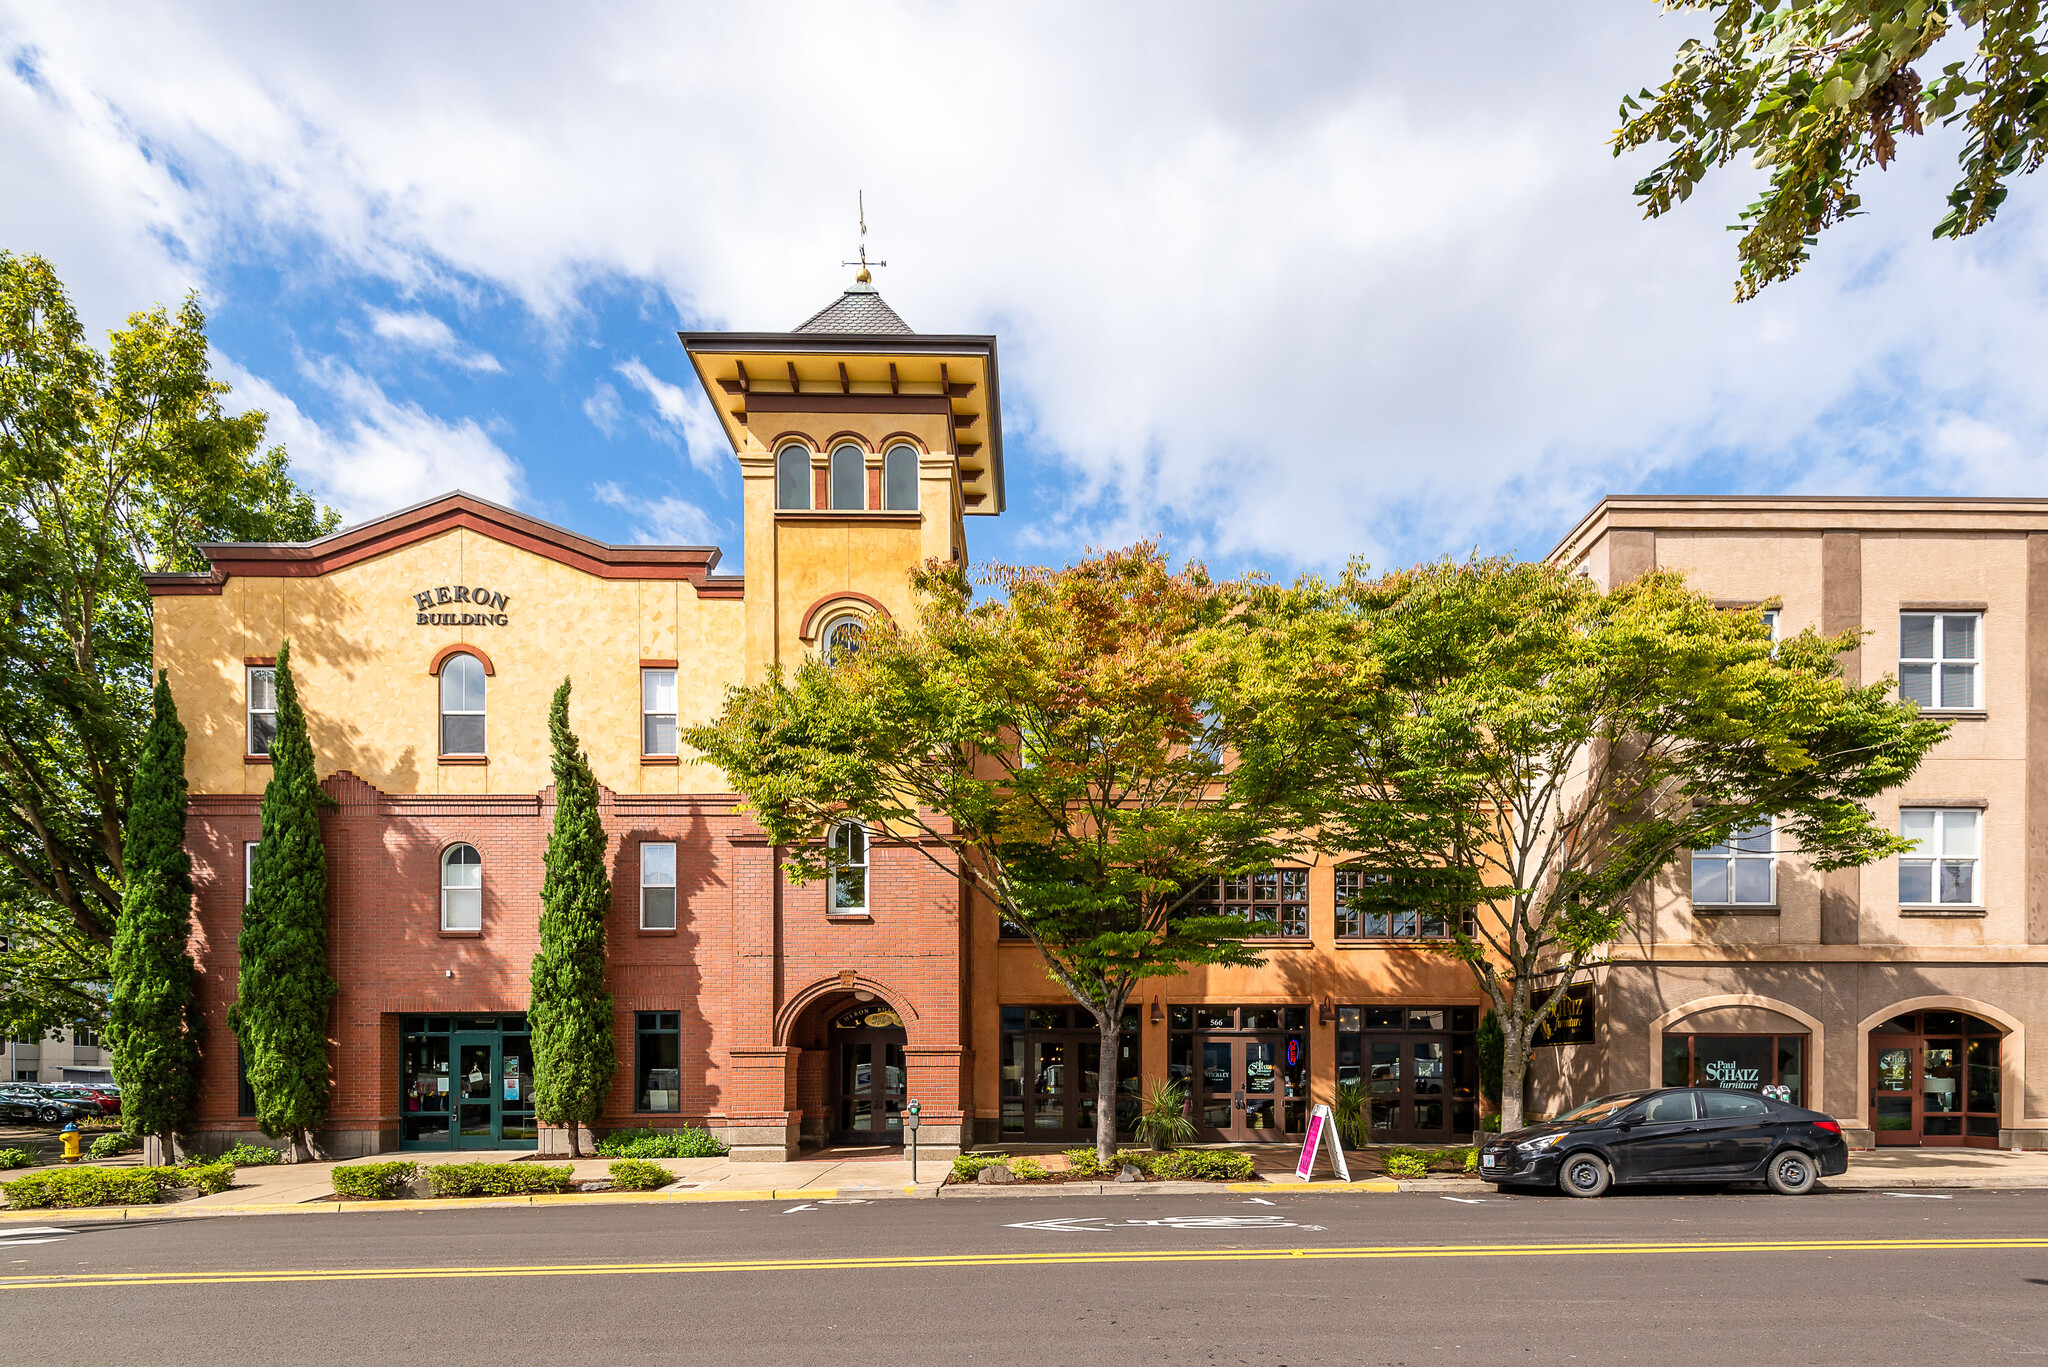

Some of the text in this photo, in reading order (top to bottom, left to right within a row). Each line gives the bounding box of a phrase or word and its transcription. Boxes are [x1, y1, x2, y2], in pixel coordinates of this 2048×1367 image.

[413, 585, 511, 613] HERON
[416, 613, 509, 627] BUILDING
[843, 1008, 869, 1022] HERON
[1706, 1062, 1759, 1081] SCHATZ
[1717, 1060, 1737, 1070] Paul
[1719, 1079, 1759, 1090] furniture
